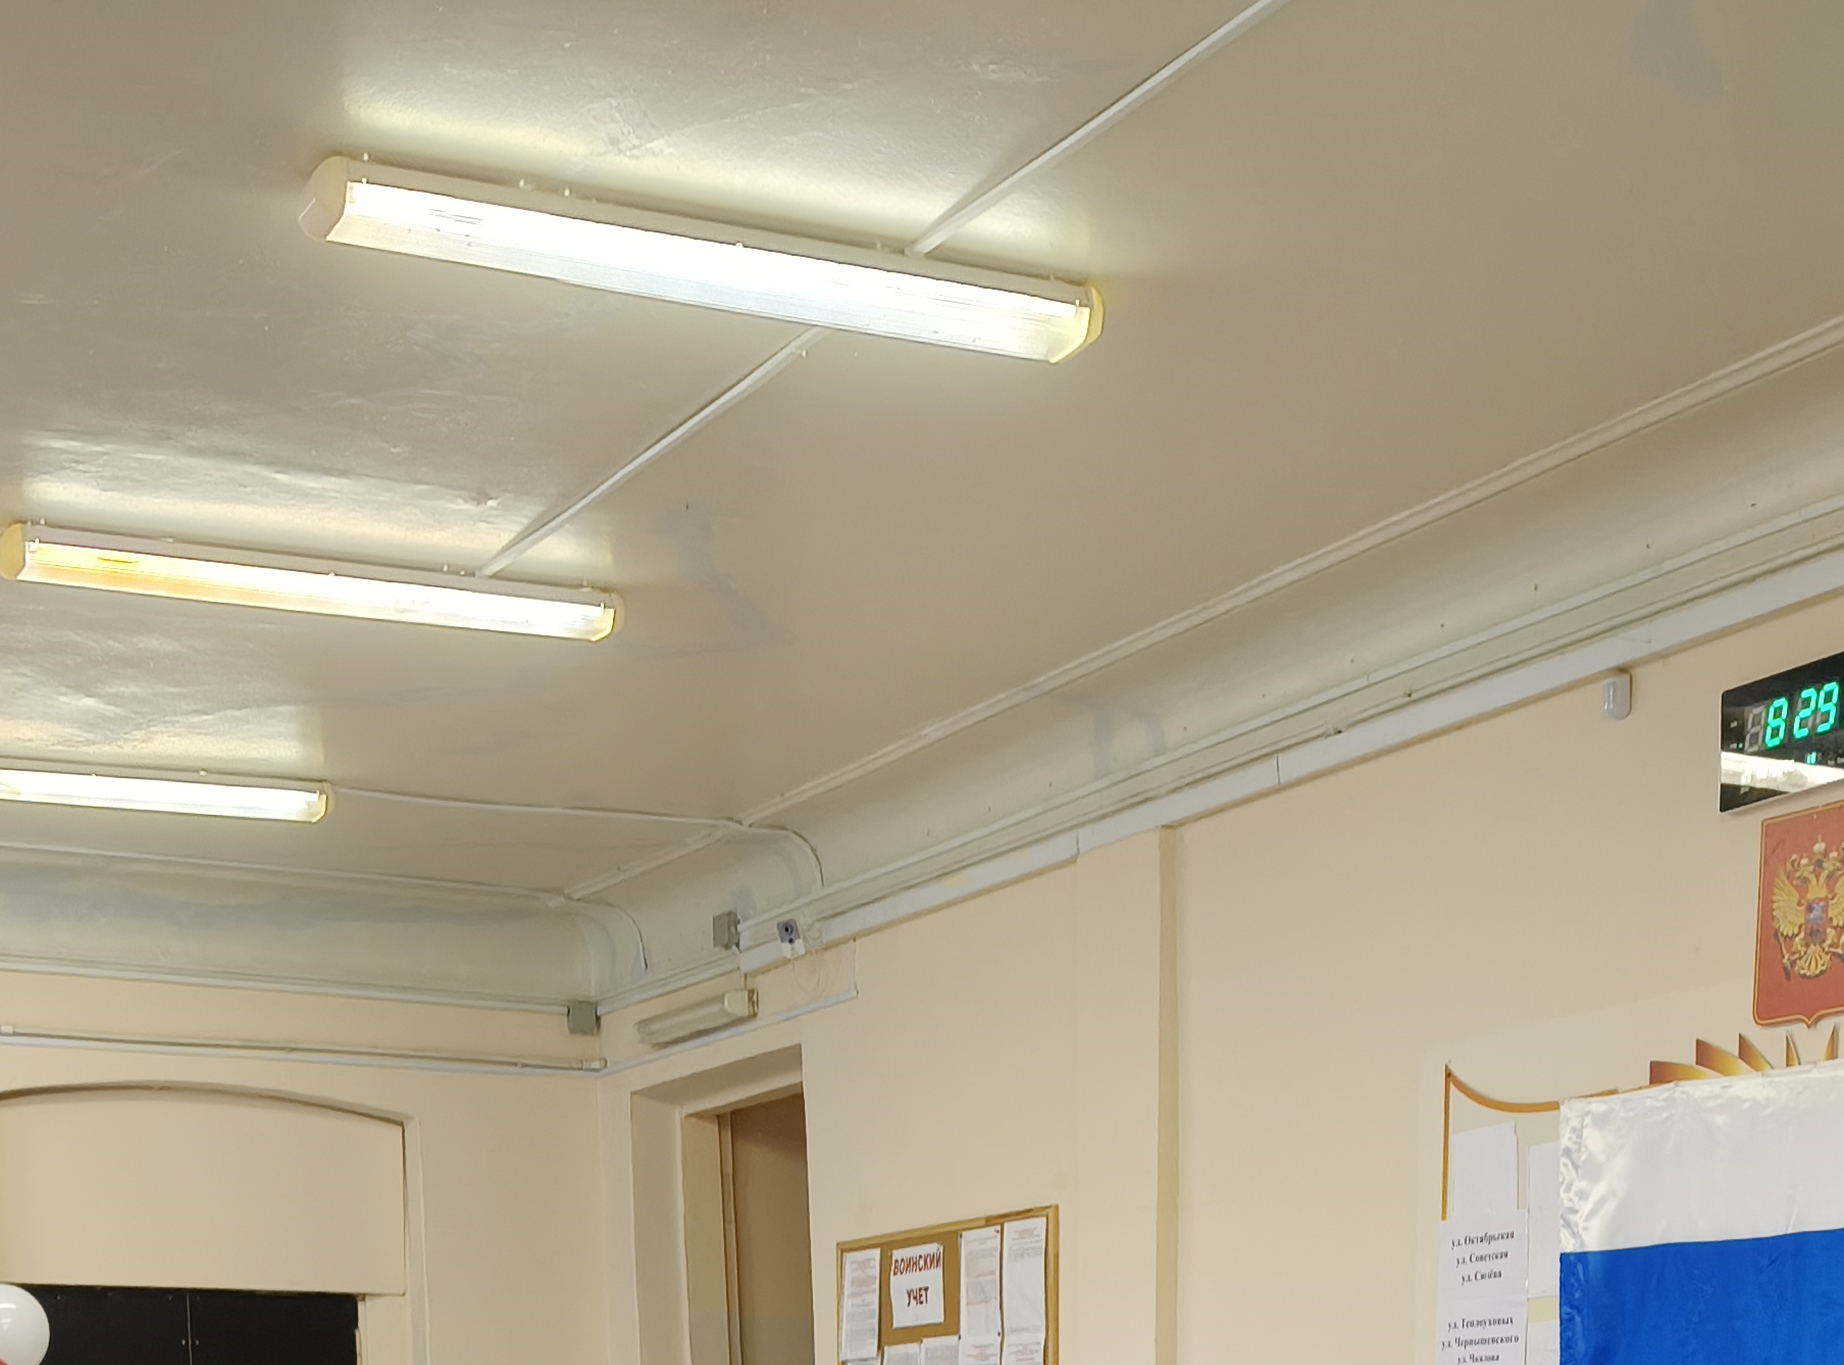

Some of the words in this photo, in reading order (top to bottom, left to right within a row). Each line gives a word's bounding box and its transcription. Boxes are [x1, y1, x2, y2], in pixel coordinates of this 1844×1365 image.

[1464, 1230, 1515, 1246] Октябрьская
[893, 1246, 942, 1277] ВОИНСКИЙ
[1469, 1251, 1509, 1264] Советская
[906, 1285, 929, 1308] УЧЕТ
[1454, 1335, 1520, 1351] Чернышевского
